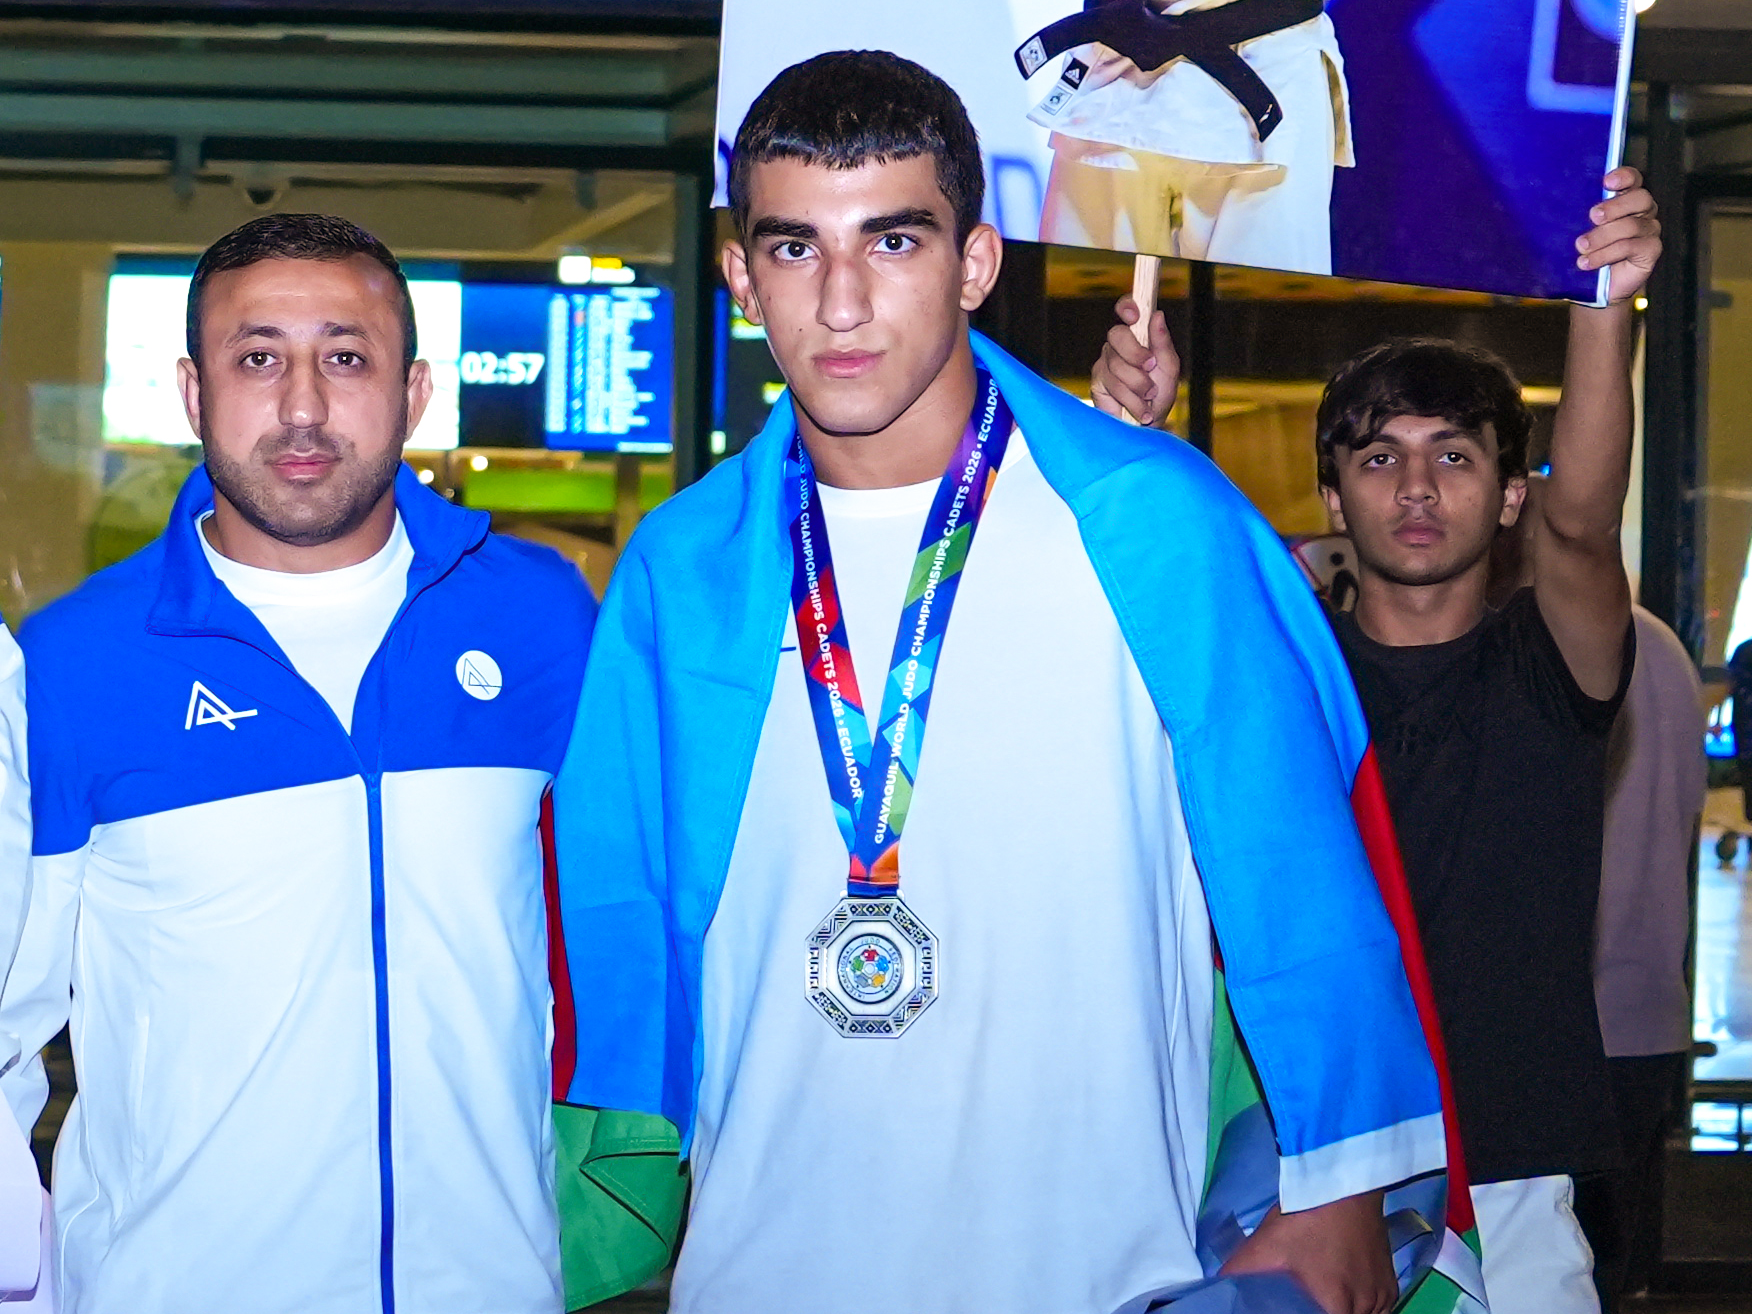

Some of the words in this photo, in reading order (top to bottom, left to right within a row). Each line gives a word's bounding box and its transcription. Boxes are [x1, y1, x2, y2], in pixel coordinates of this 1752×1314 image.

[460, 351, 545, 384] 02:57
[799, 477, 810, 511] JUDO
[800, 512, 825, 621] CHAMPIONSHIPS
[816, 623, 837, 679] CADETS
[875, 761, 900, 844] GUAYAQUIL
[891, 702, 909, 757] WORLD
[903, 659, 918, 699] JUDO
[911, 537, 951, 656] CHAMPIONSHIPS
[943, 485, 970, 537] CADETS
[962, 450, 982, 484] 2026
[827, 682, 845, 717] 2026
[838, 727, 864, 799] ECUADOR
